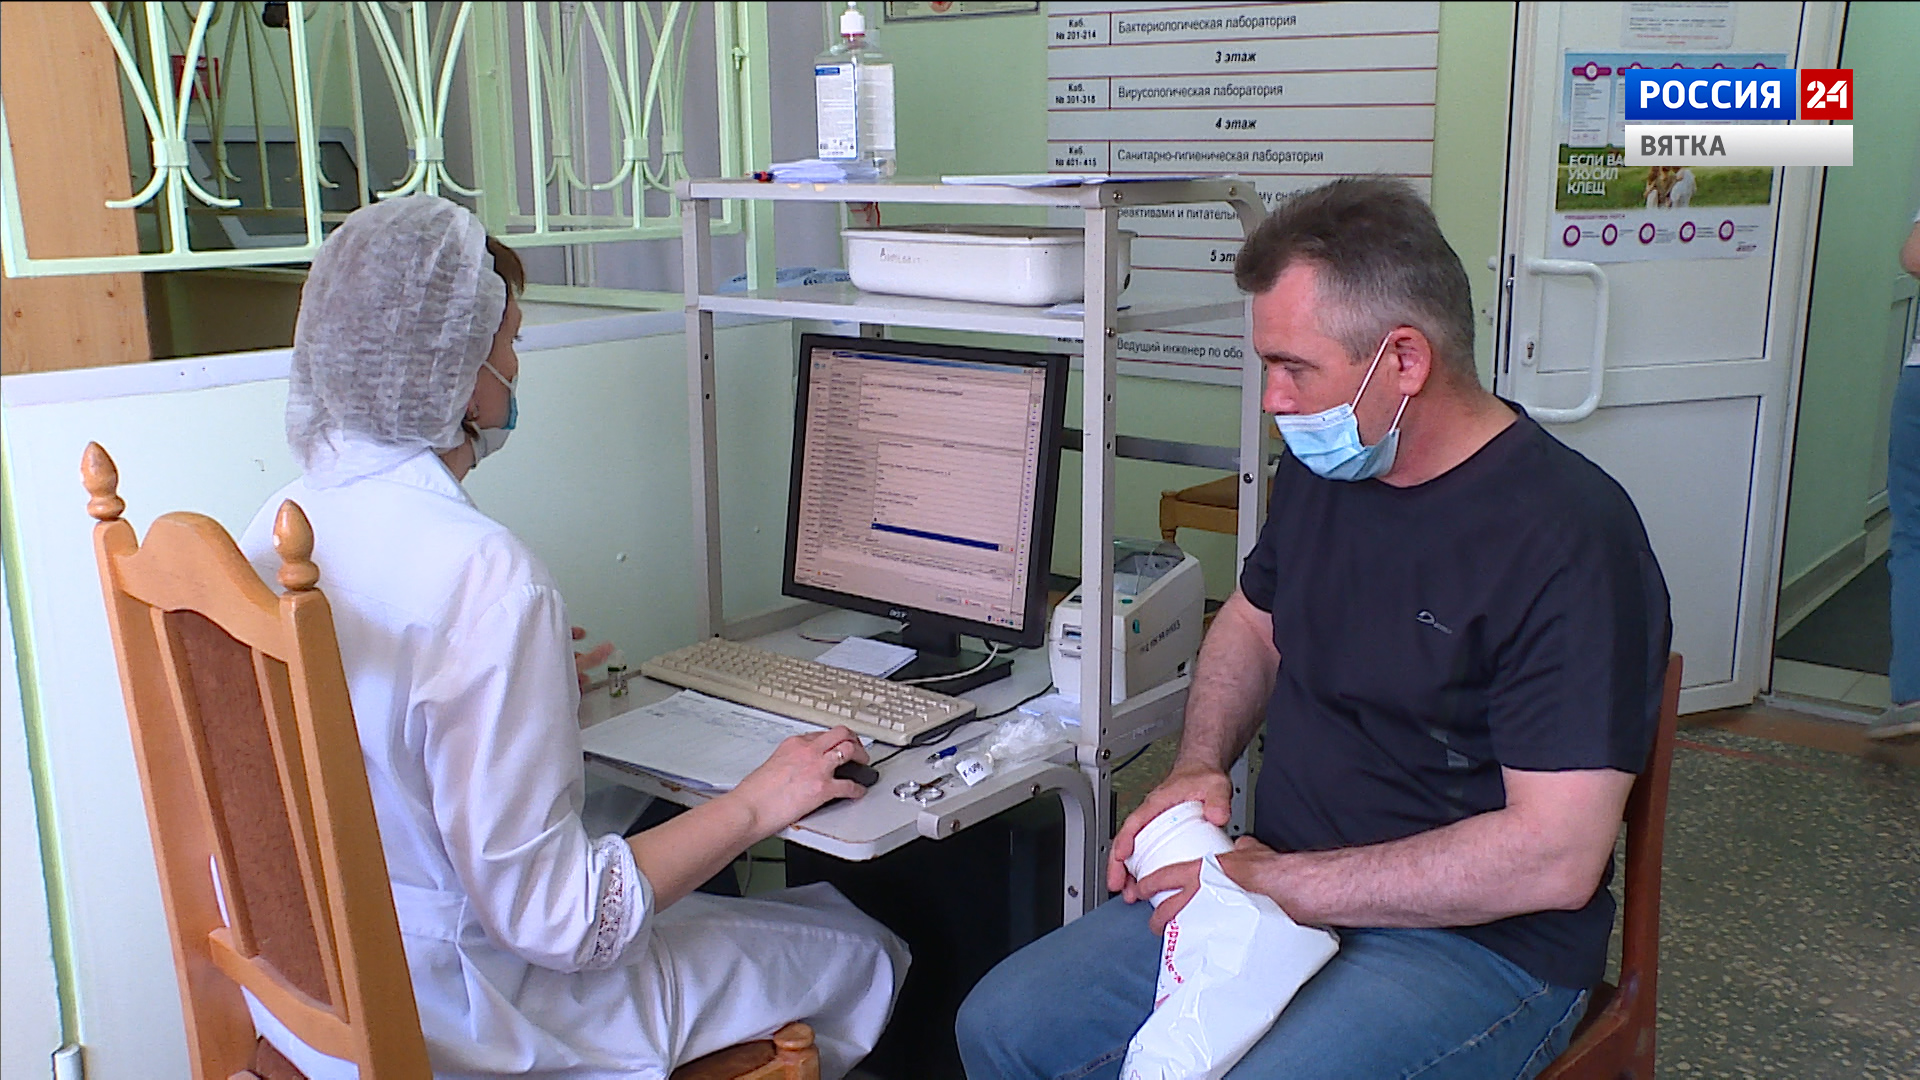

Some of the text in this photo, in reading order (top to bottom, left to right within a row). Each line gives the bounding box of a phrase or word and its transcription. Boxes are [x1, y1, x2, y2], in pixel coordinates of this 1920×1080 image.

[1118, 15, 1297, 34] Бактериологическая лаборатория
[1215, 50, 1257, 63] 3 этаж
[1118, 83, 1283, 100] Вирусологическая лаборатория
[1215, 118, 1257, 129] 4 этаж
[1117, 149, 1324, 163] Санитарно-гигиеническая лаборатория
[1569, 153, 1625, 167] ЕСЛИ ВА
[1568, 167, 1619, 181] УКУСИЛ
[1567, 181, 1606, 196] КЛЕЩ
[1186, 209, 1240, 220] питательн
[1210, 250, 1236, 262] 5 эт
[1208, 346, 1221, 357] по
